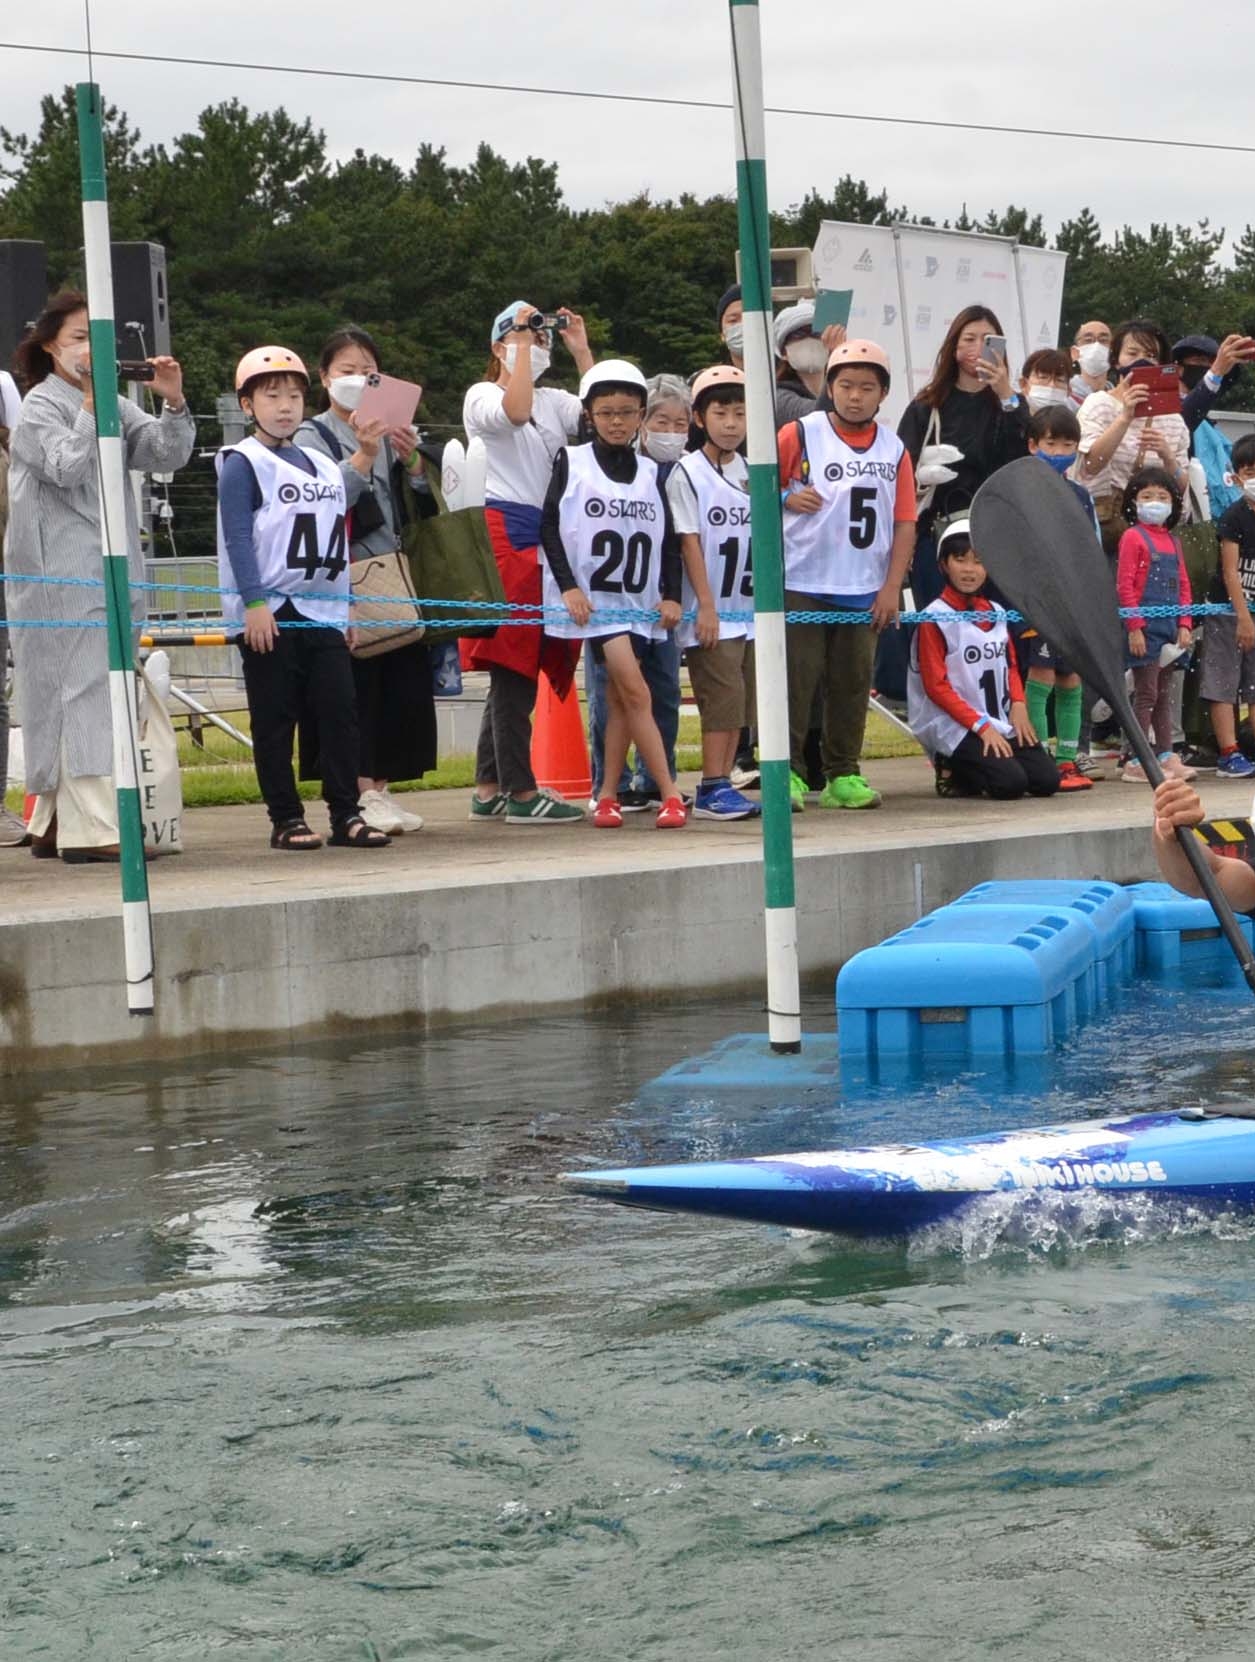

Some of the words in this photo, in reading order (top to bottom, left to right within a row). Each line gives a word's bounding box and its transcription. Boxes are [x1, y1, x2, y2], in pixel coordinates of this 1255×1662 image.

[286, 513, 347, 582] 44
[849, 486, 877, 549] 5
[590, 530, 652, 593] 20
